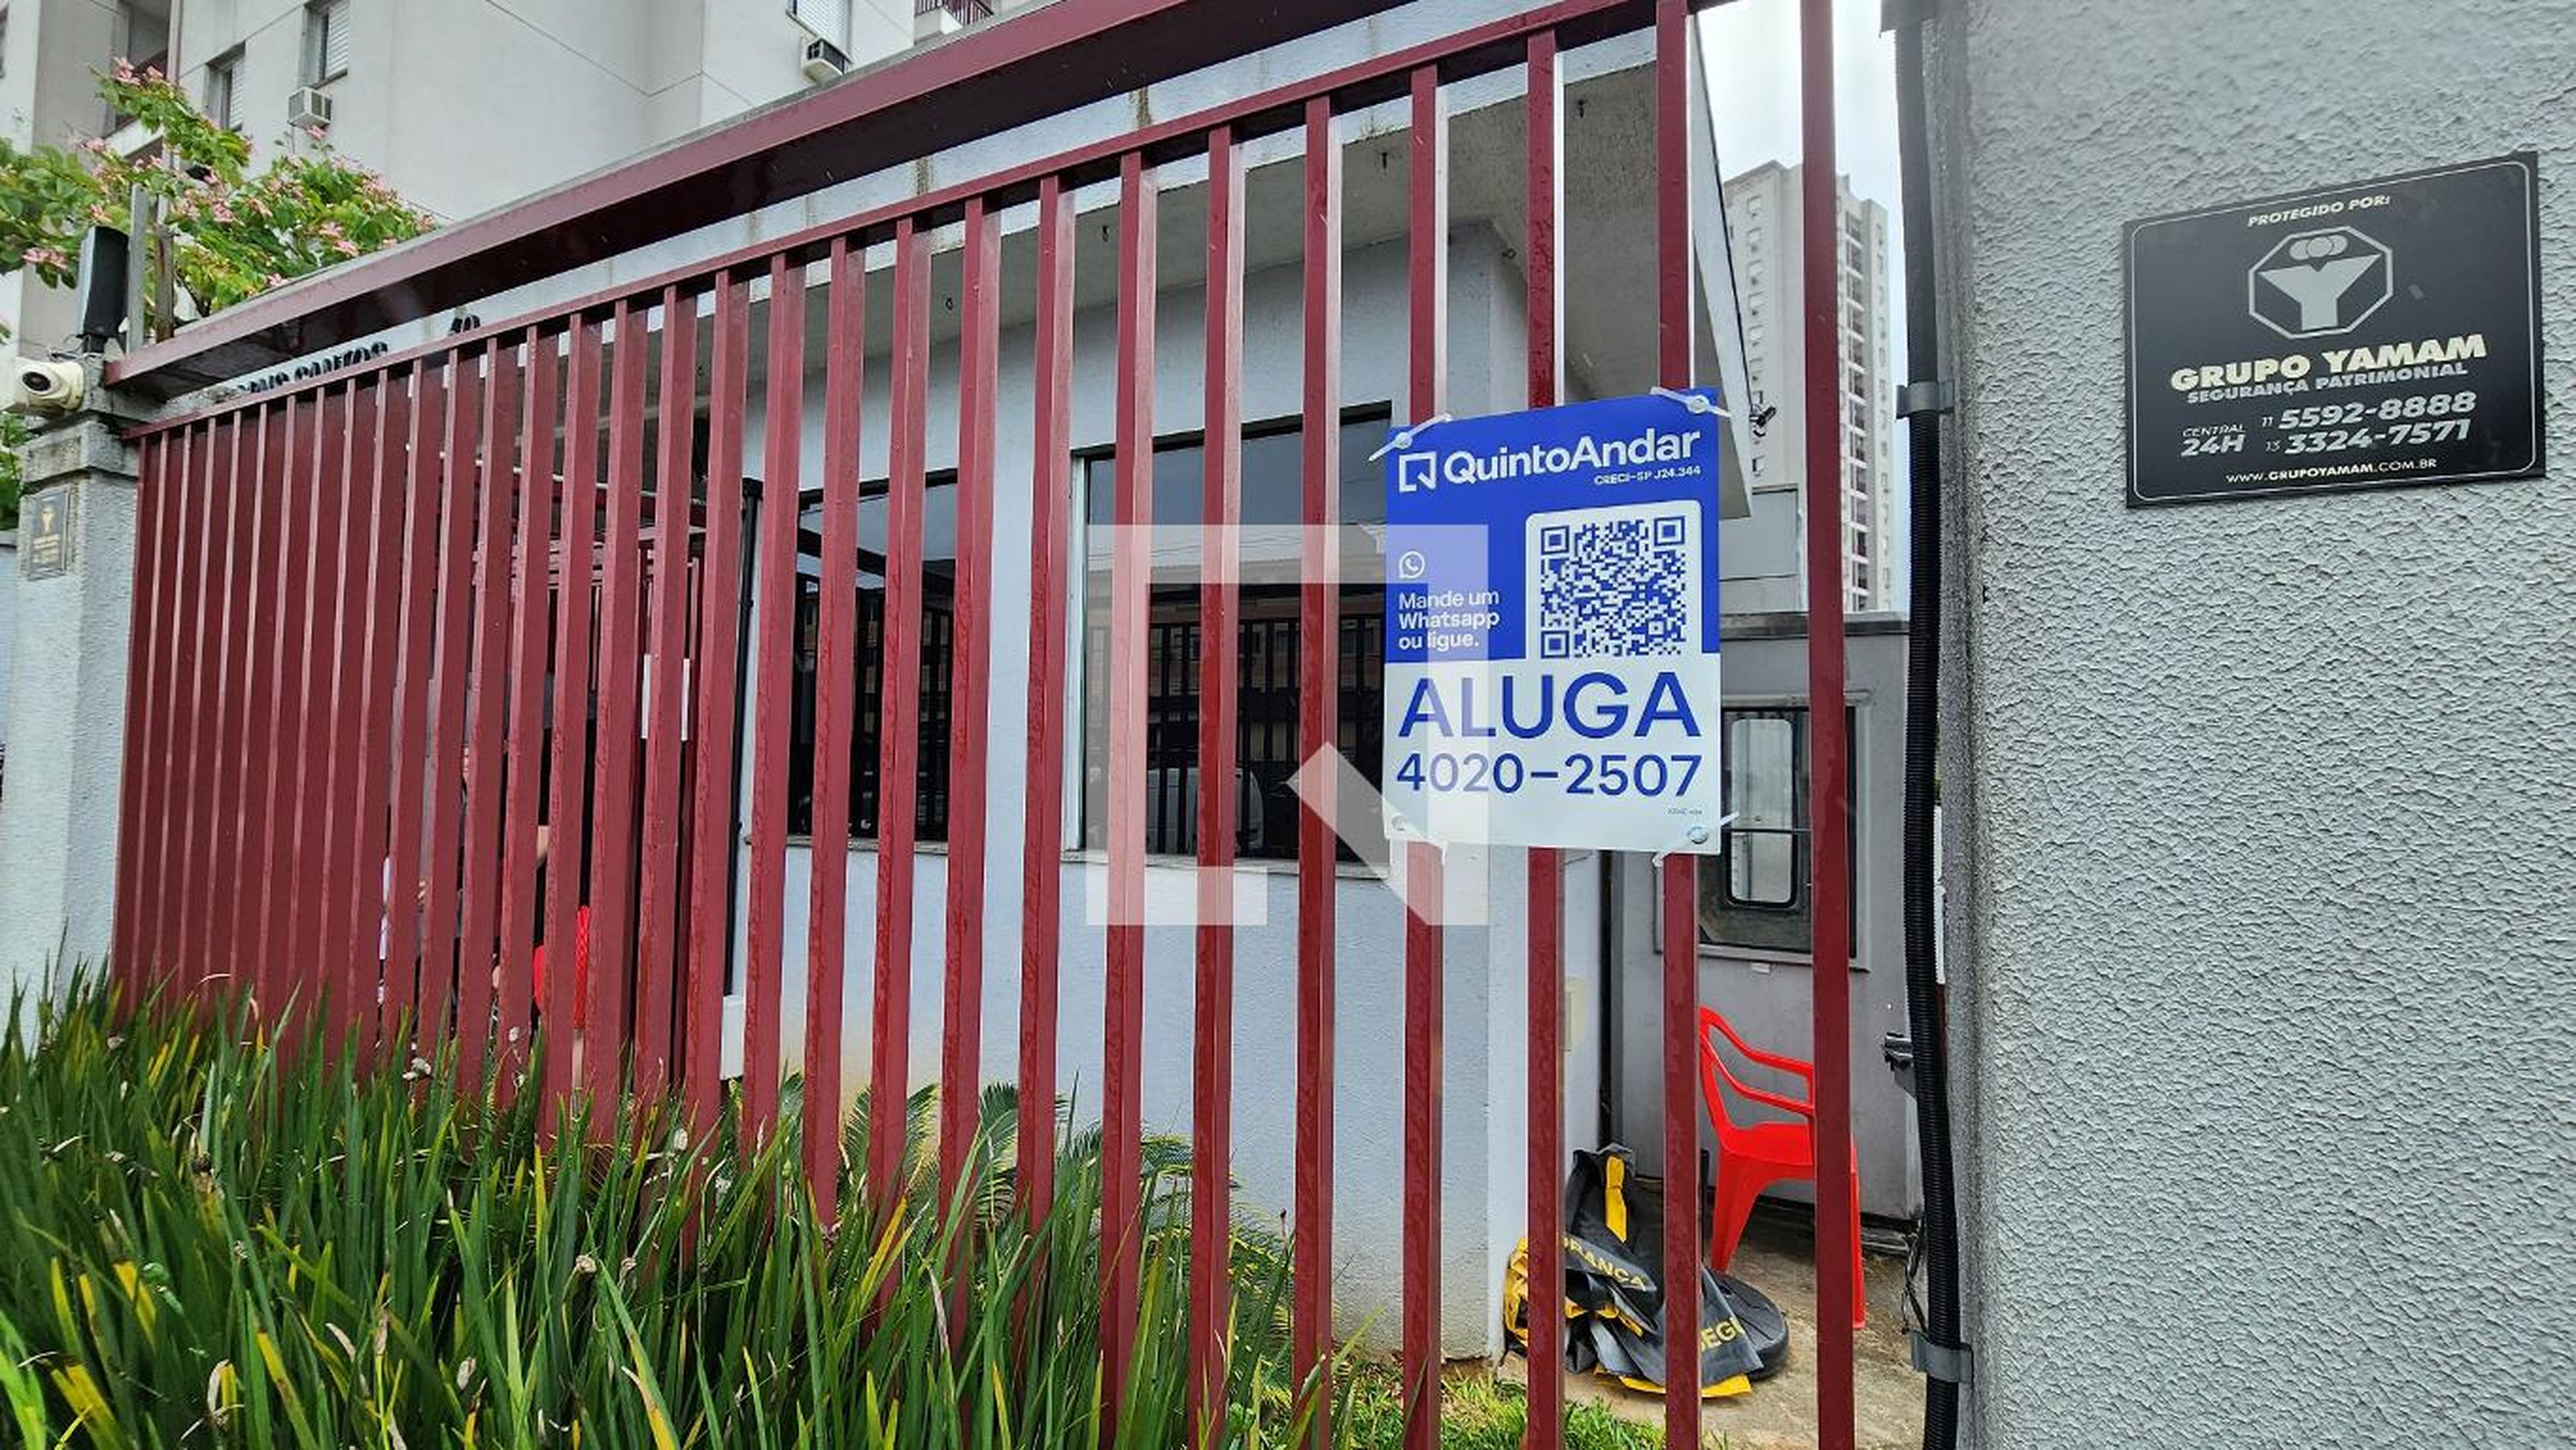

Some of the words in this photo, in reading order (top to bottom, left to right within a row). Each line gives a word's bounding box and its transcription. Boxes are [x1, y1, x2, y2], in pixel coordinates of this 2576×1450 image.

[2247, 201, 2345, 227] PROTEGIDO
[2349, 195, 2390, 211] POR:
[2171, 354, 2311, 392] GRUPO
[2321, 333, 2487, 374] YAMAM
[2187, 379, 2310, 404] SEGURANÇA
[2316, 362, 2468, 390] PATRIMONIAL
[2279, 391, 2477, 429] 5592-8888
[2180, 433, 2246, 458] 24H
[2182, 423, 2246, 438] CENTRAL
[2284, 419, 2472, 455] 3324-7571
[1444, 429, 1701, 484] QuintoAndar
[1594, 471, 1652, 485] CRECI-SP
[1654, 465, 1701, 480] J24.344
[1399, 590, 1464, 610] Mande
[1468, 590, 1499, 605] um
[1399, 610, 1500, 630] Whatsapp
[1399, 635, 1423, 649] ou
[1427, 630, 1479, 652] ligue.
[1398, 671, 1702, 739] ALUGA
[1397, 752, 1703, 797] 4020-2507
